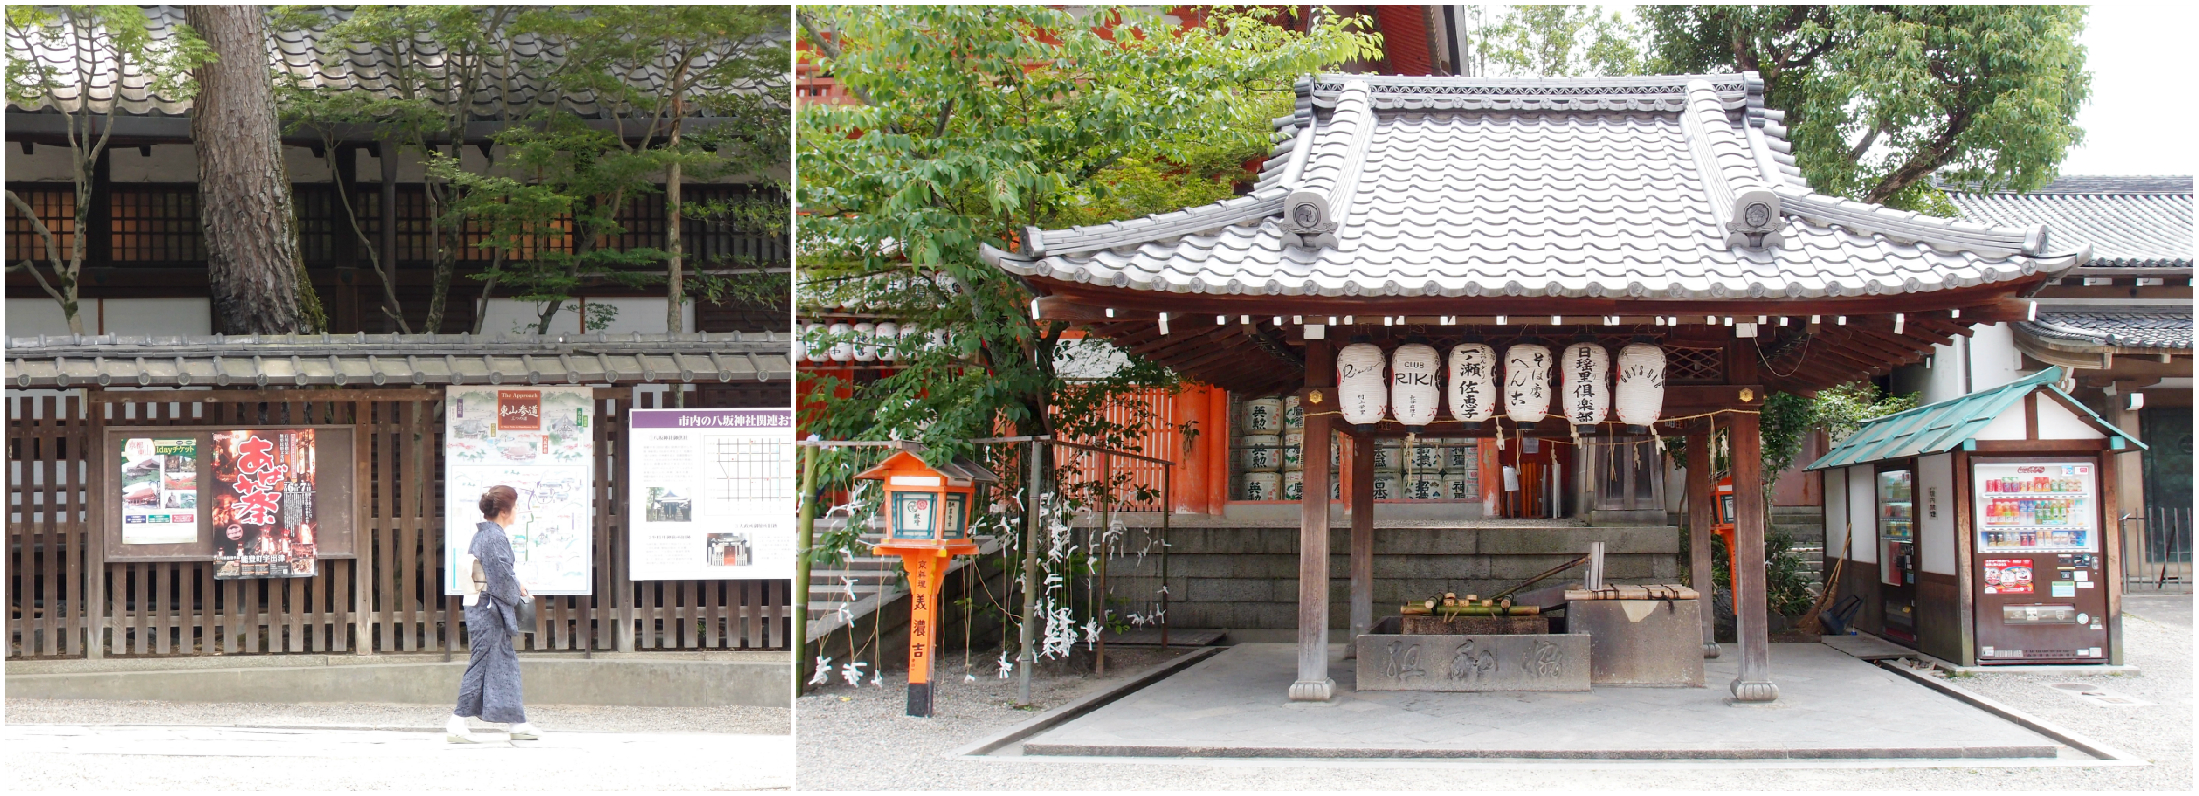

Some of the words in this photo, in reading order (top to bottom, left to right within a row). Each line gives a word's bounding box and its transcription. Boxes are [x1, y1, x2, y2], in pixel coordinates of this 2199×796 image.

[1404, 361, 1425, 369] CLUB
[1395, 372, 1433, 387] RIKI
[499, 404, 539, 418] 東山参道
[678, 414, 791, 427] 市内の八坂神社関連お
[156, 445, 195, 455] 1dayチケット
[917, 559, 927, 589] 京料理
[912, 593, 927, 659] 美濃吉
